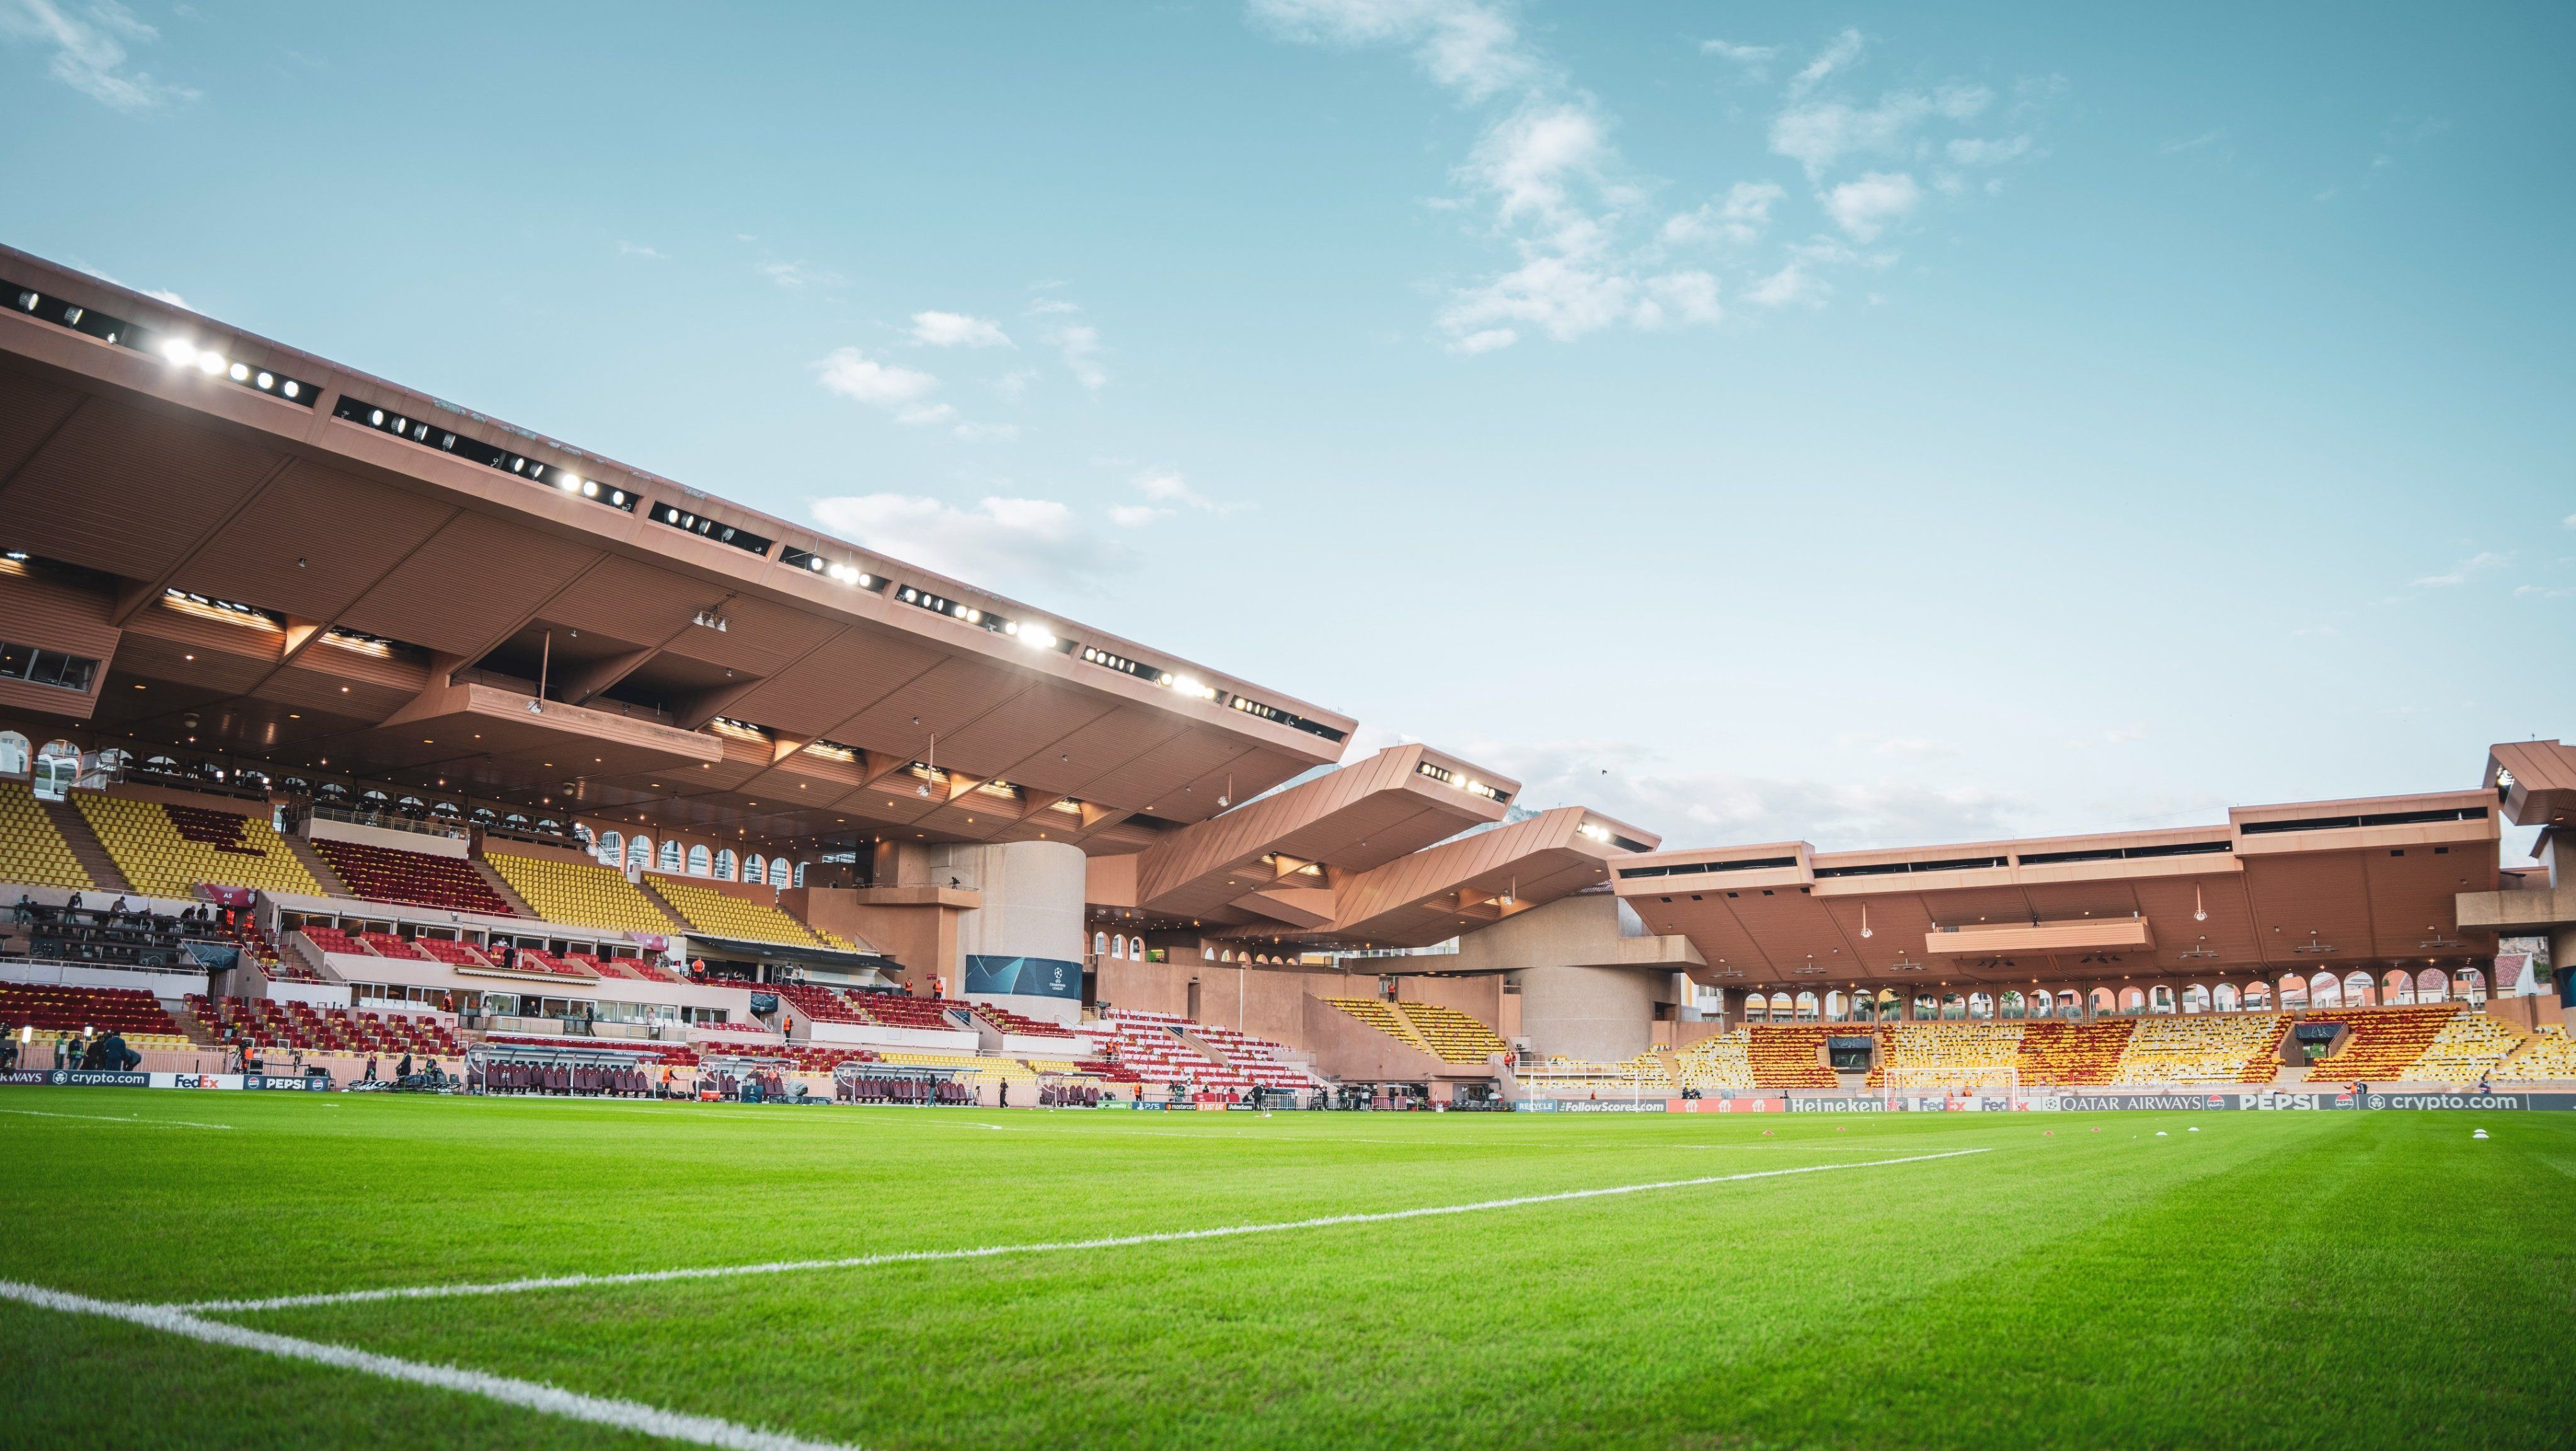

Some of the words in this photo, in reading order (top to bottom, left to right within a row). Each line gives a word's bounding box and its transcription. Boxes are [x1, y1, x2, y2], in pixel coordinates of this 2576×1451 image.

[71, 1072, 145, 1084] crypto.com
[175, 1074, 219, 1089] FedEx
[266, 1078, 306, 1089] PEPSI
[1791, 1098, 1885, 1112] Heineken
[1919, 1097, 1967, 1111] FedEx
[2063, 1097, 2119, 1111] QATAR
[2128, 1096, 2201, 1110] AIRWAYS
[2240, 1094, 2319, 1110] PEPSI
[2392, 1094, 2518, 1110] crypto.com
